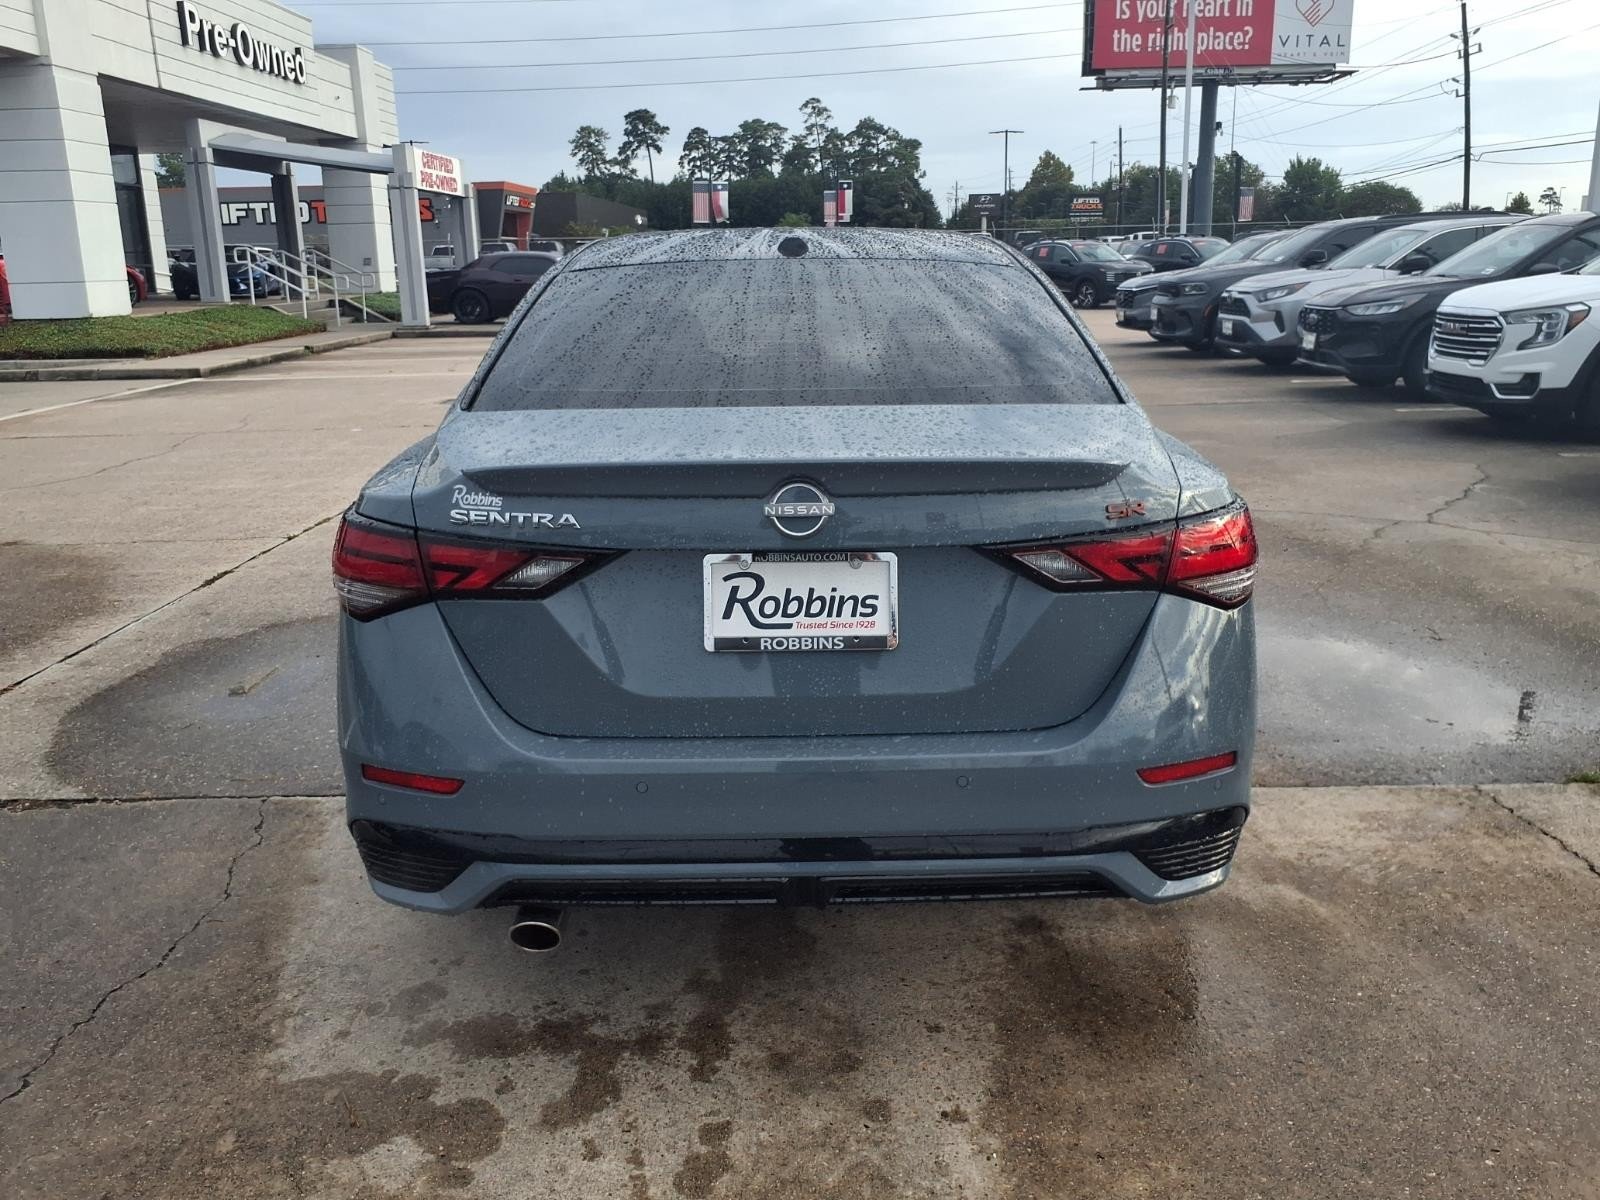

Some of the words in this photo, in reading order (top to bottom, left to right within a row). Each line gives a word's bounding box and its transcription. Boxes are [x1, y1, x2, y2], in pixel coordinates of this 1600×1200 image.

[1116, 0, 1130, 19] Is
[177, 1, 306, 84] Pre-Owned
[1113, 28, 1142, 53] the
[1197, 26, 1253, 54] place?
[1278, 33, 1345, 48] VITAL
[421, 151, 454, 174] CERTIFIED
[420, 170, 457, 193] PRE-OWNED
[452, 484, 503, 511] Robbins
[450, 509, 581, 529] SENTRA
[764, 503, 834, 516] NISSAN
[1105, 502, 1146, 520] SR
[755, 553, 846, 563] ROBBINSAUTO.COM
[722, 571, 880, 630] Robbins
[795, 621, 828, 630] Trusted
[830, 621, 854, 629] Since
[855, 620, 876, 629] 1928
[760, 636, 845, 650] ROBBINS
